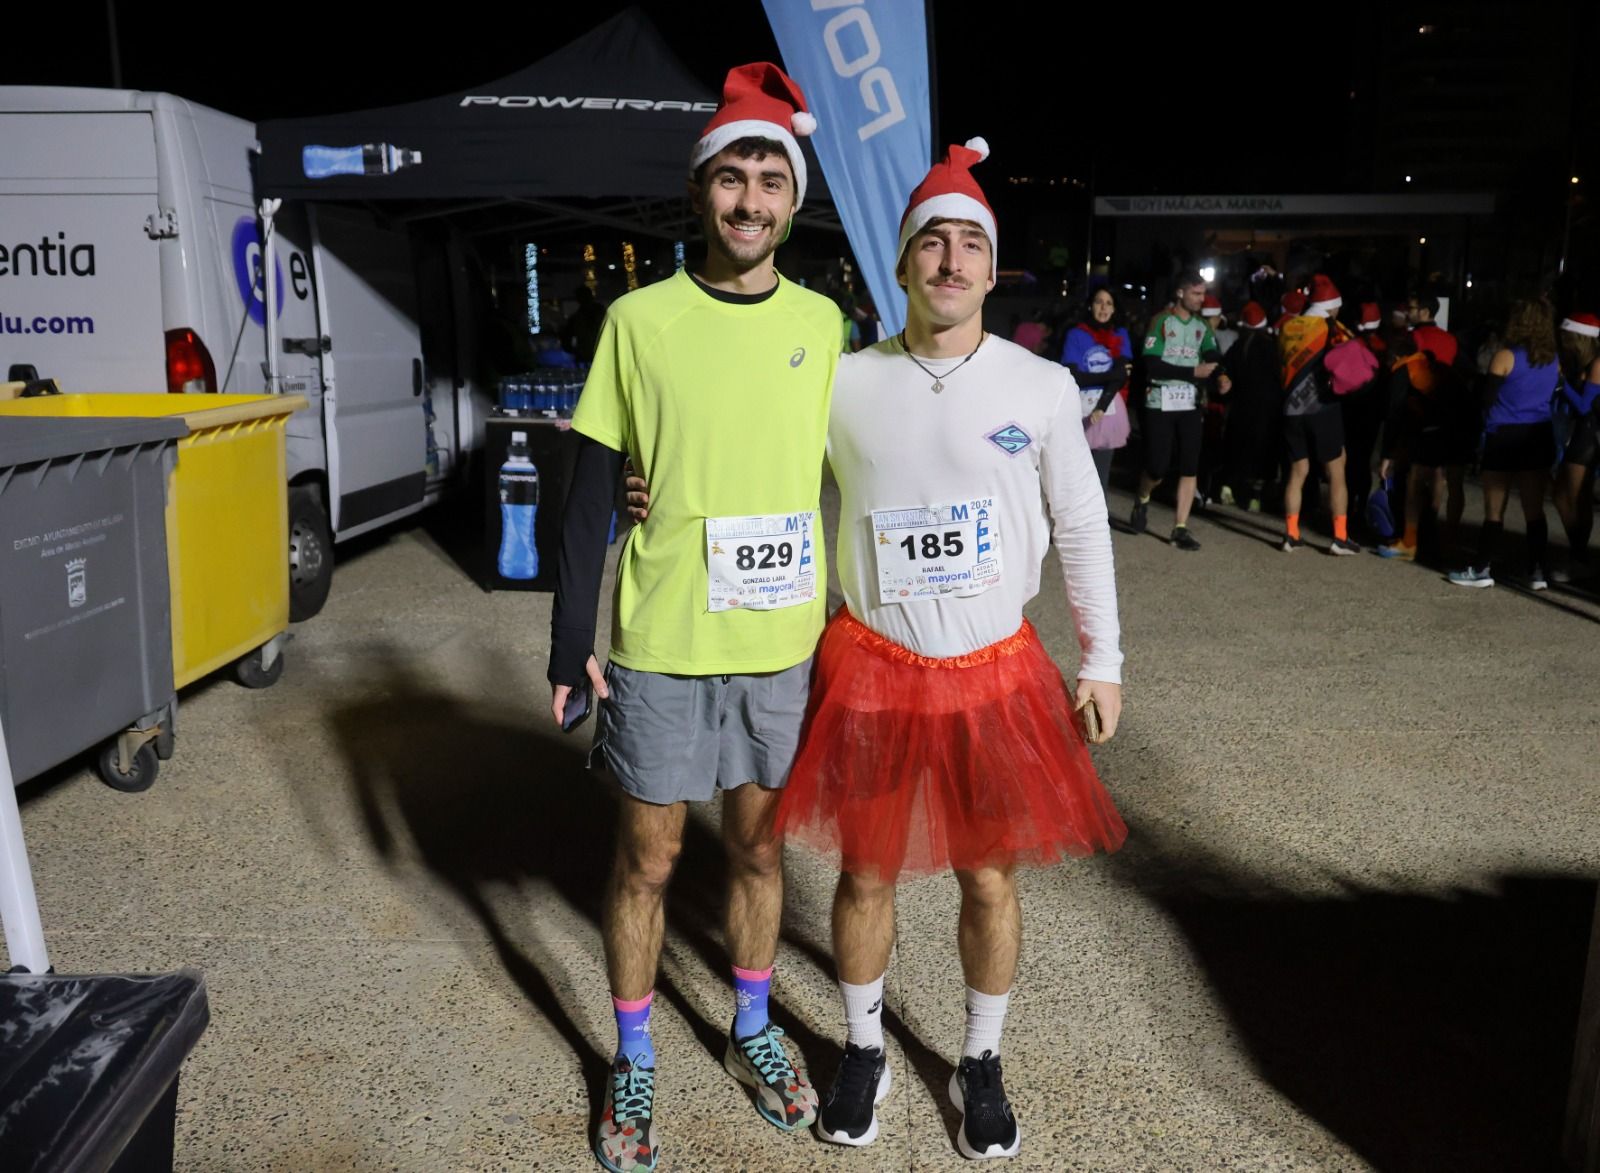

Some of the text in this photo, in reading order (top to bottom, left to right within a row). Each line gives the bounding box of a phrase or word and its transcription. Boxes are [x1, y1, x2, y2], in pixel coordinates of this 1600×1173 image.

[460, 95, 718, 112] POWERAD
[0, 312, 94, 334] u.com
[971, 498, 992, 510] 2024
[900, 531, 964, 561] 185
[736, 542, 793, 571] 829
[742, 577, 771, 585] GONZALO
[928, 570, 972, 584] mayoral
[759, 580, 794, 594] mayoral
